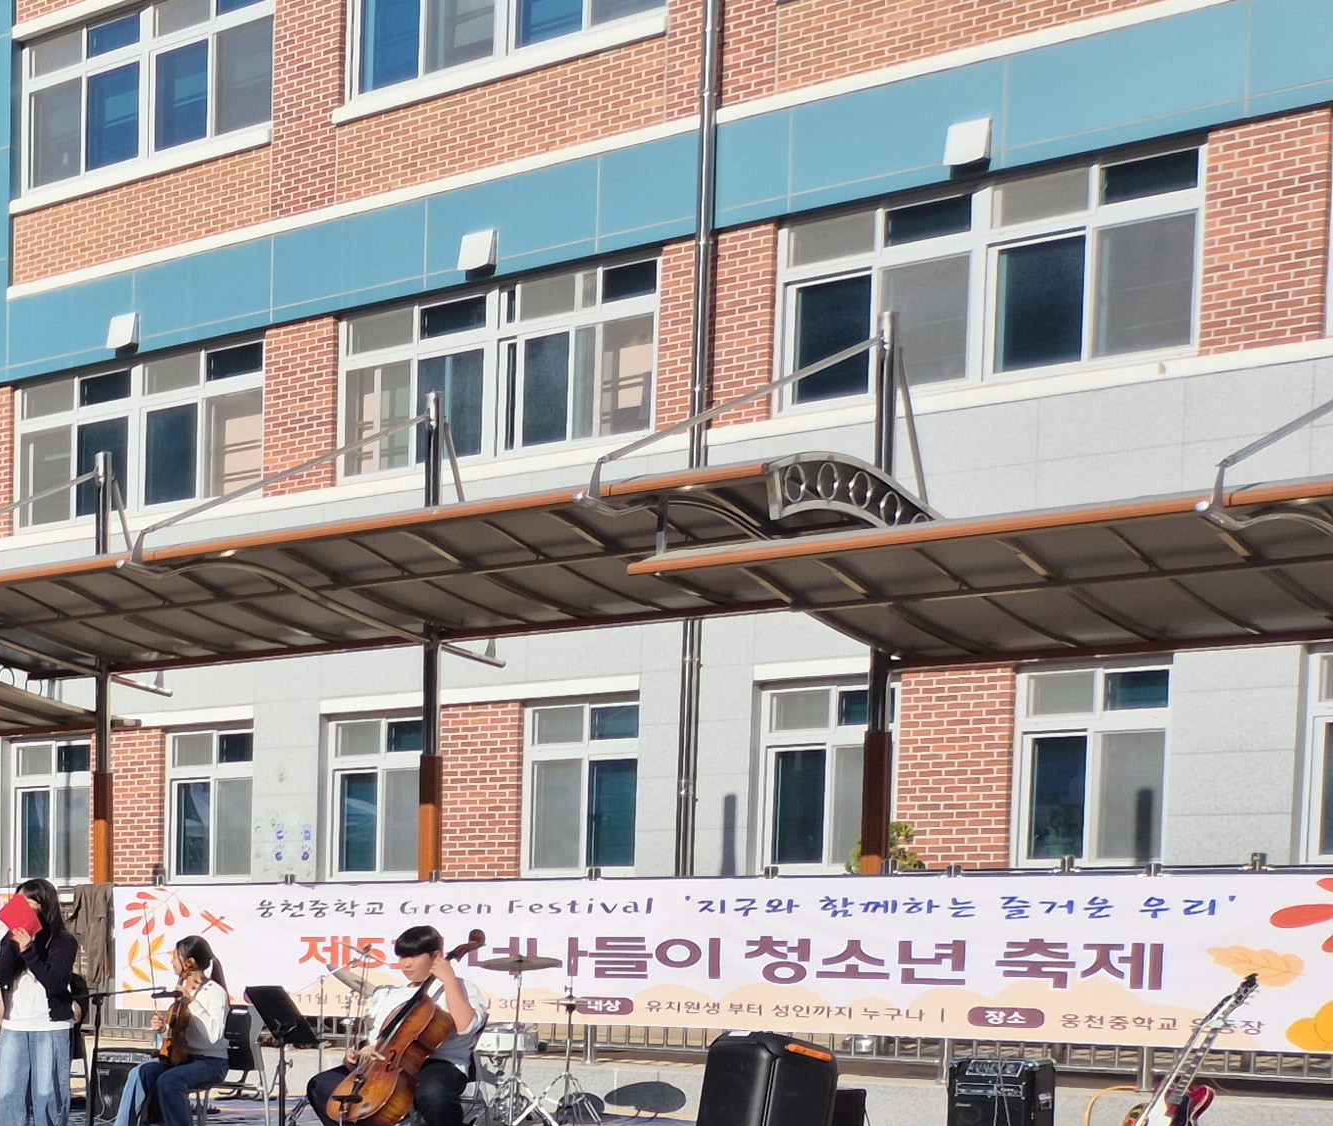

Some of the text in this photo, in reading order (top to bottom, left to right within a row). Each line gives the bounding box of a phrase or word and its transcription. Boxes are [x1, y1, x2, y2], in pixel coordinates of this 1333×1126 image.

[256, 898, 384, 918] 웅천중학교
[399, 899, 491, 915] Green
[507, 897, 653, 915] Festival
[819, 895, 976, 918] 함께하는
[999, 895, 1114, 920] 즐거운
[298, 936, 444, 971] 제5
[744, 935, 967, 985] 청소년
[995, 938, 1164, 991] 축제
[646, 1000, 720, 1015] 유치원생
[728, 1002, 763, 1016] 부터
[771, 1004, 853, 1019] 성인까지
[861, 1007, 926, 1022] 누구나
[984, 1009, 1027, 1025] 장소
[1059, 1013, 1179, 1031] 웅천중학교
